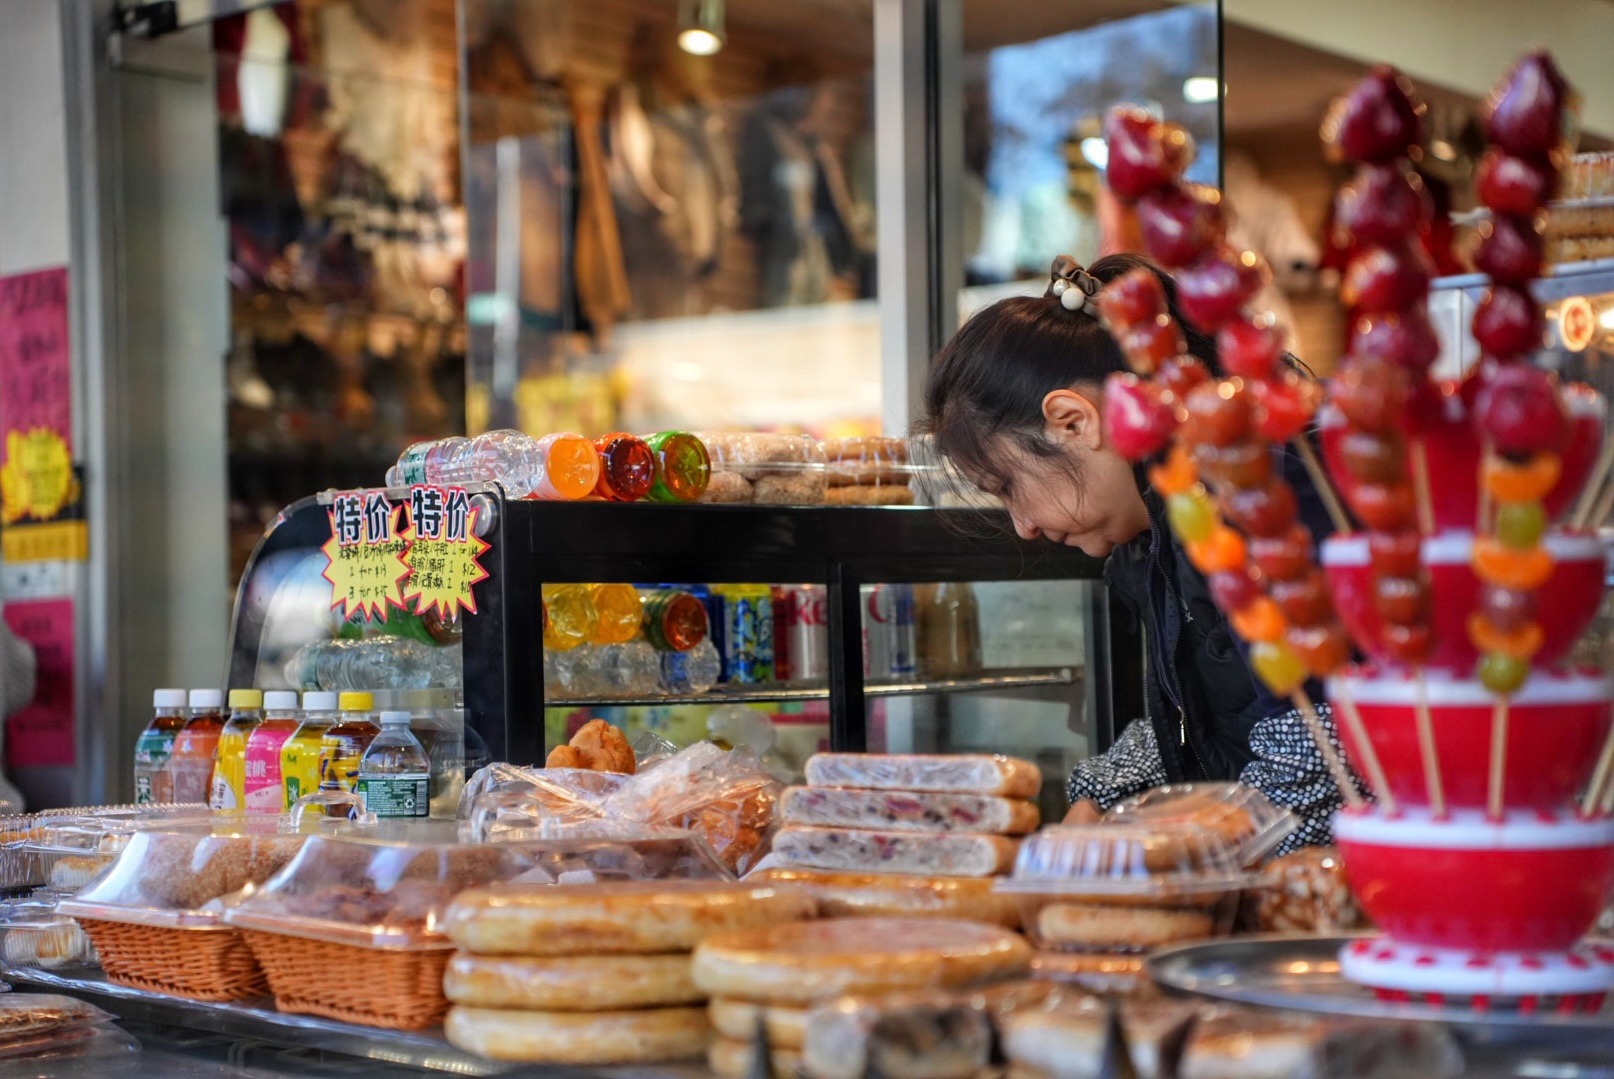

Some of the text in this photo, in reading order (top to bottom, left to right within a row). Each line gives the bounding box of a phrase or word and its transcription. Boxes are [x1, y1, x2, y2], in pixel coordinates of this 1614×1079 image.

[335, 492, 391, 543] 特价
[412, 488, 469, 541] 特价
[462, 562, 476, 576] $12
